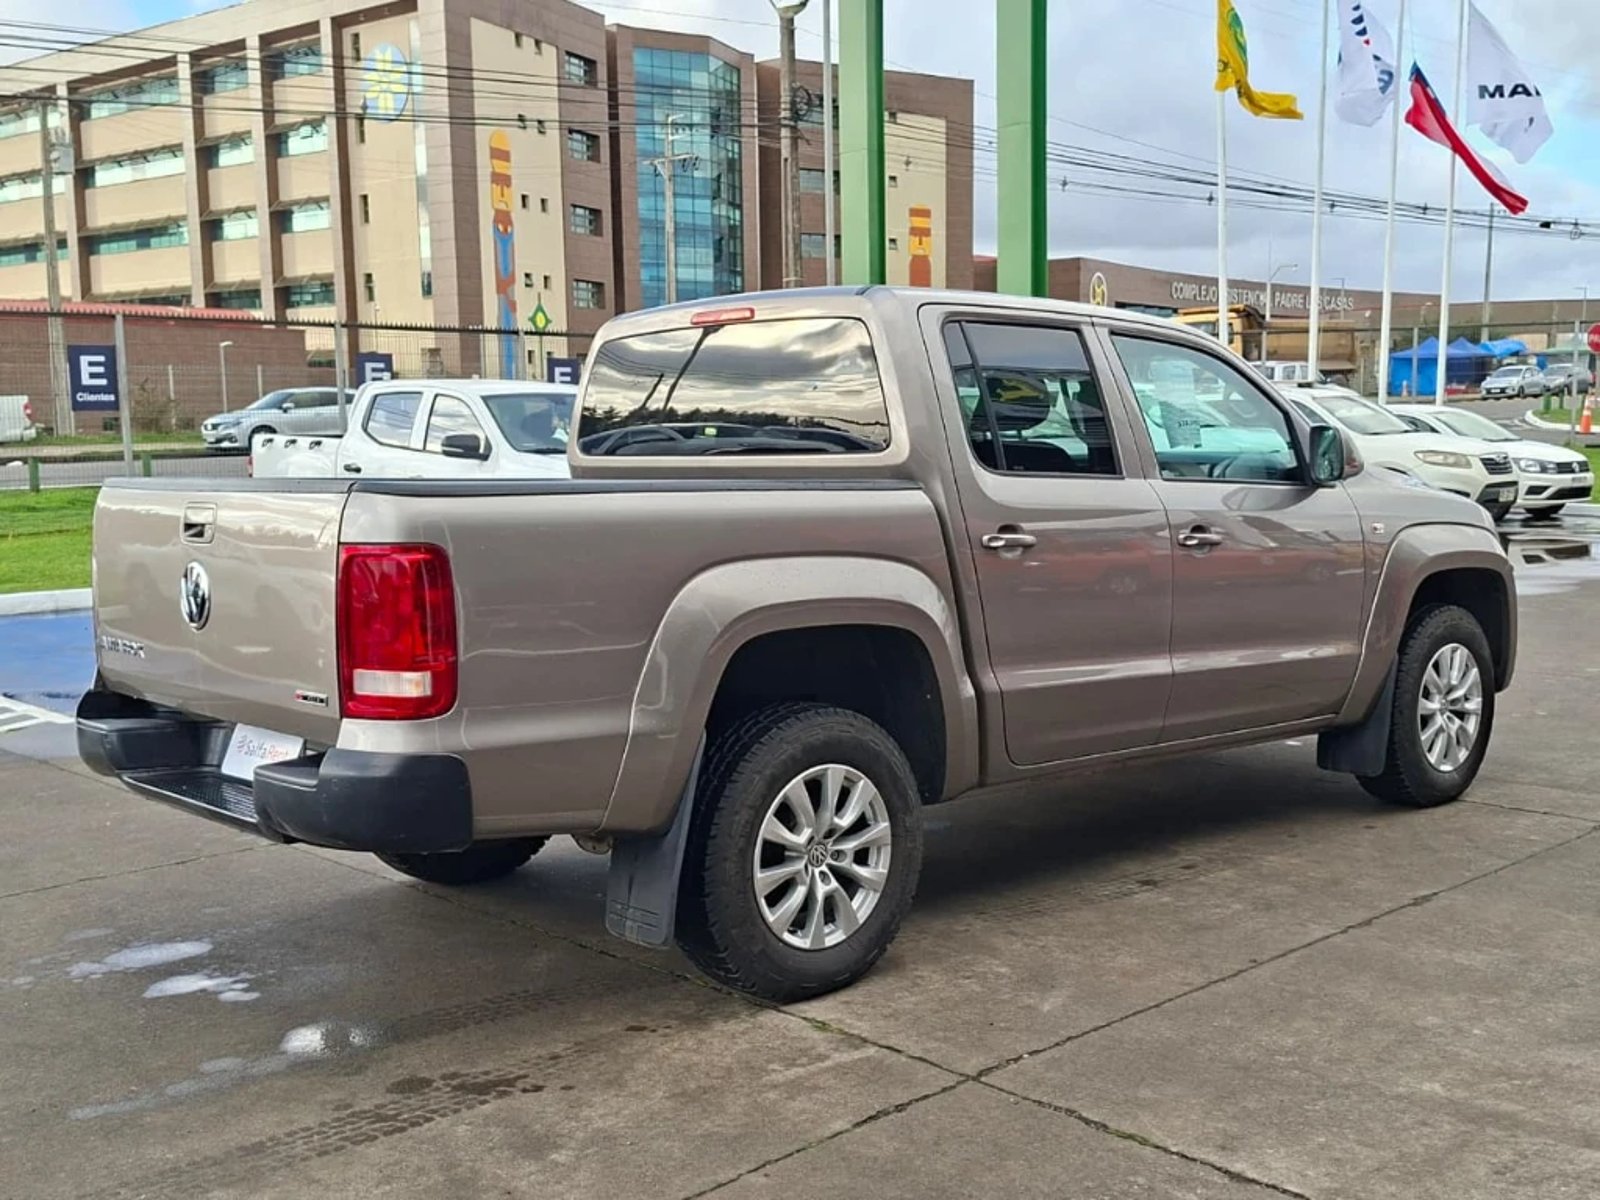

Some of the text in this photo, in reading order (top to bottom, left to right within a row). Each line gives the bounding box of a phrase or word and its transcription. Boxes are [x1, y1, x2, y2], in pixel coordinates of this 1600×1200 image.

[1171, 281, 1218, 303] COMPLEJO
[1274, 291, 1304, 310] PADRE
[1306, 295, 1323, 311] LS
[1324, 295, 1354, 312] CASAS
[79, 355, 108, 386] E
[76, 391, 115, 402] Clientes
